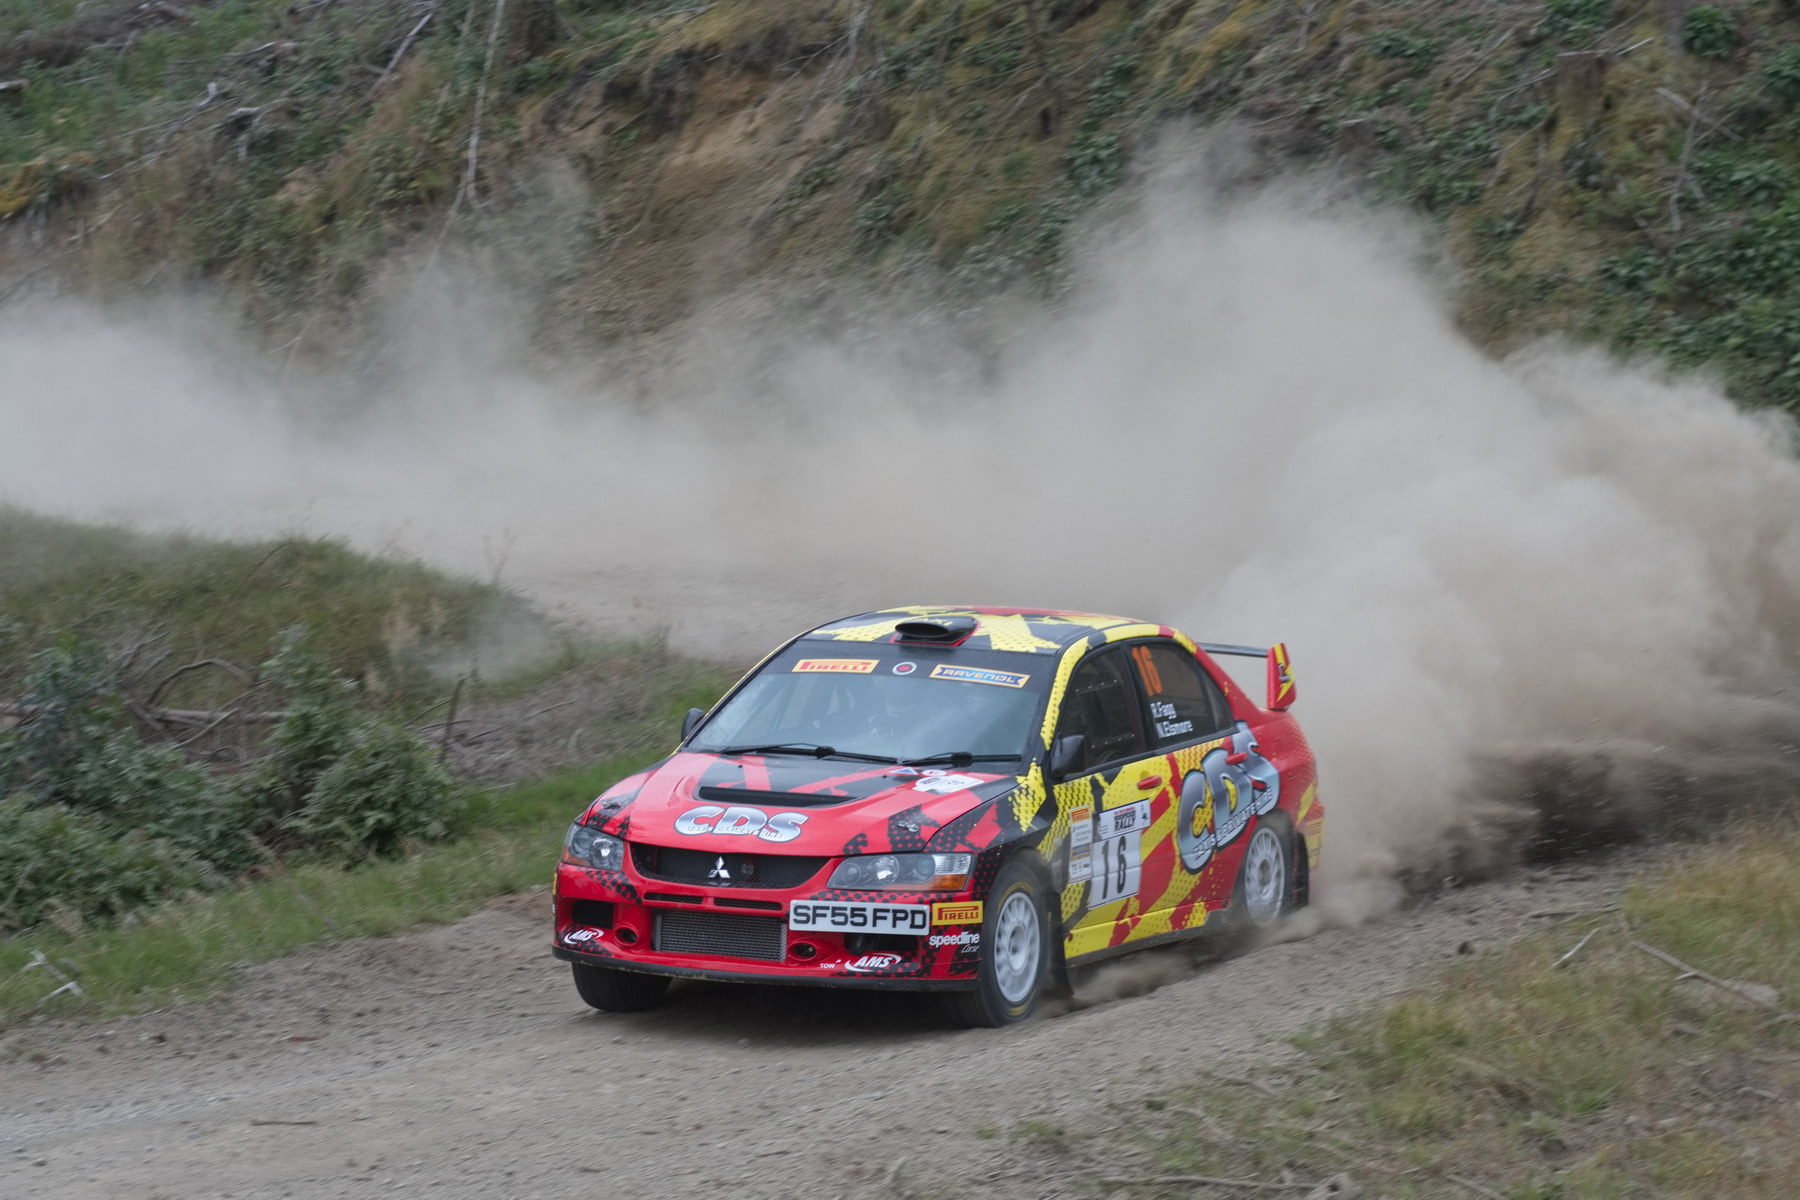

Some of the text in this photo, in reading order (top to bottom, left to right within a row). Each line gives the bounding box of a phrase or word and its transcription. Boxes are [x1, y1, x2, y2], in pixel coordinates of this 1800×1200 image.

[799, 661, 872, 671] PIRELLI
[1132, 646, 1163, 696] 16
[943, 669, 1017, 684] RAVENOL
[1178, 721, 1280, 874] CDS
[674, 805, 810, 843] CDS
[1114, 816, 1136, 832] RALLY
[1102, 836, 1127, 900] 16
[793, 905, 927, 929] SF55 FPD
[937, 905, 979, 921] PIRELLI
[569, 929, 597, 941] AMS
[929, 931, 980, 947] speedline
[854, 956, 893, 968] AMS
